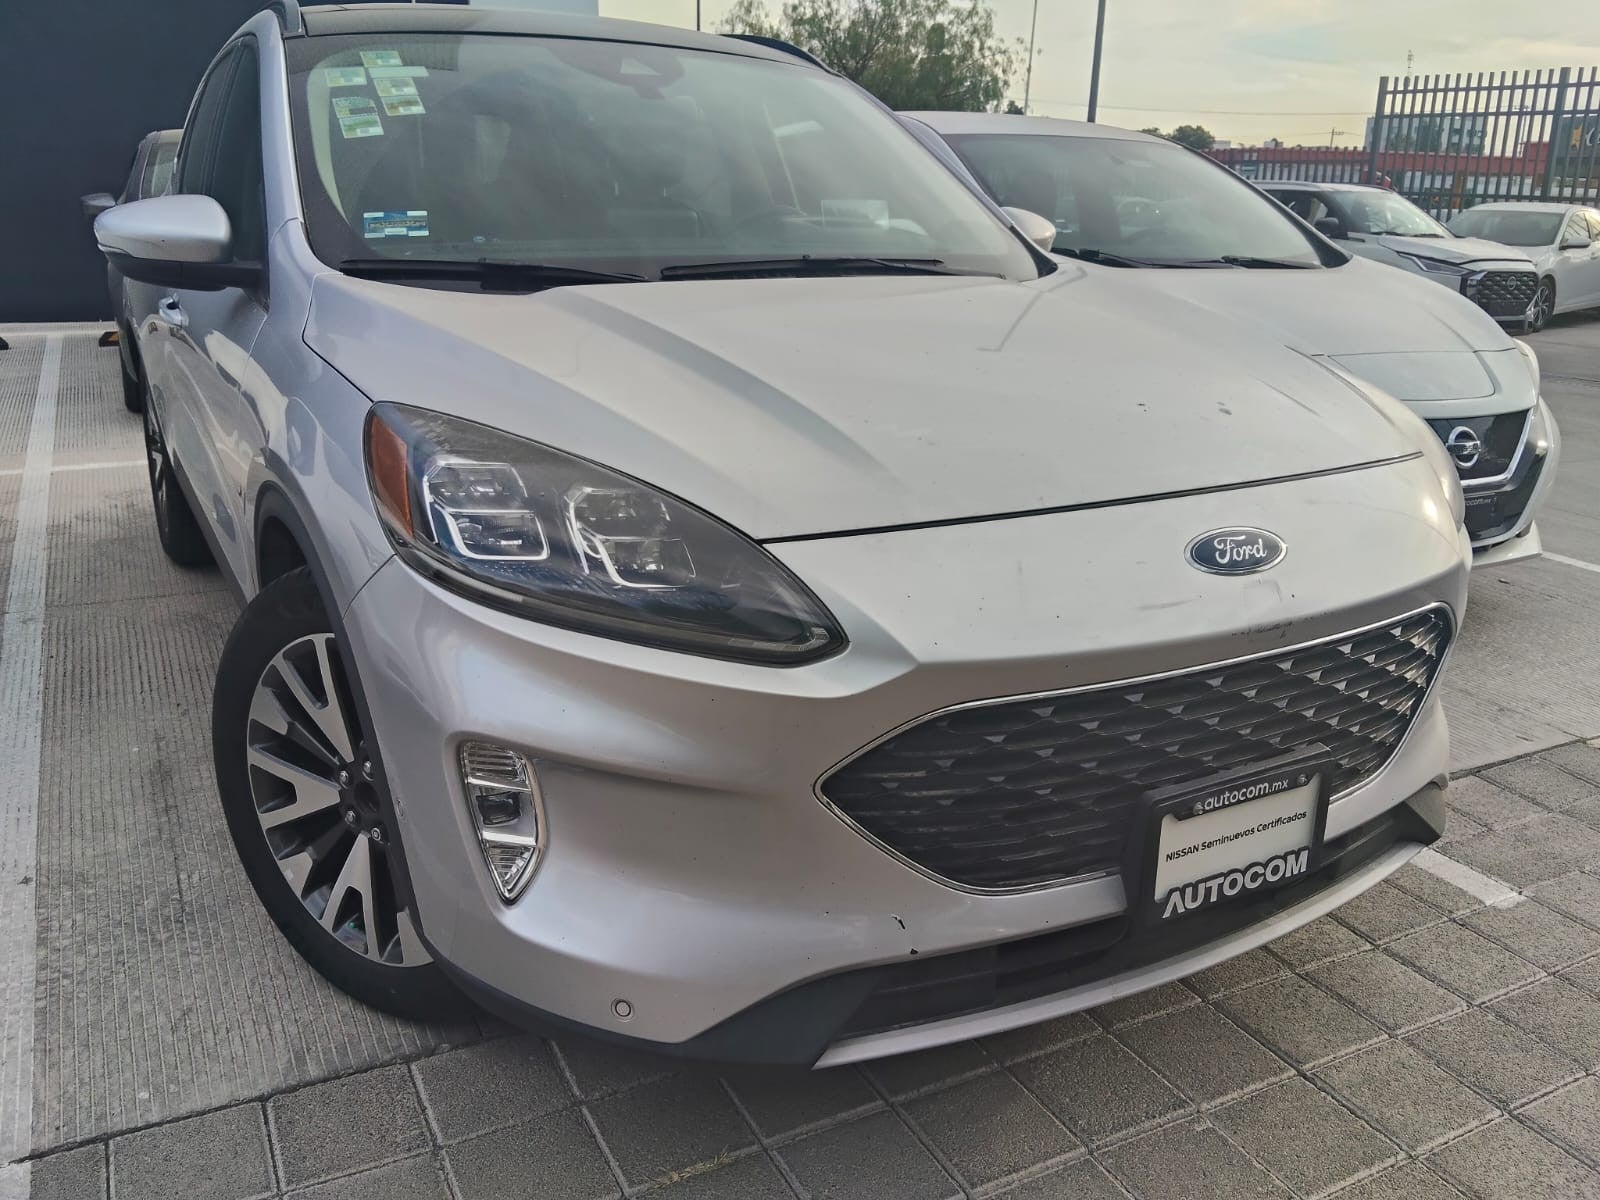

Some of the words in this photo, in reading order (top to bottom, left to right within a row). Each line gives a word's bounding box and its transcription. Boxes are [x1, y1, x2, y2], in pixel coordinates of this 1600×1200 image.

[1214, 535, 1268, 564] Ford
[1204, 779, 1289, 811] autocom.mx
[1165, 844, 1200, 862] NISSAN
[1201, 828, 1255, 850] Seminuevos
[1256, 811, 1307, 833] Certificados
[1162, 849, 1309, 919] AUTOCOM
